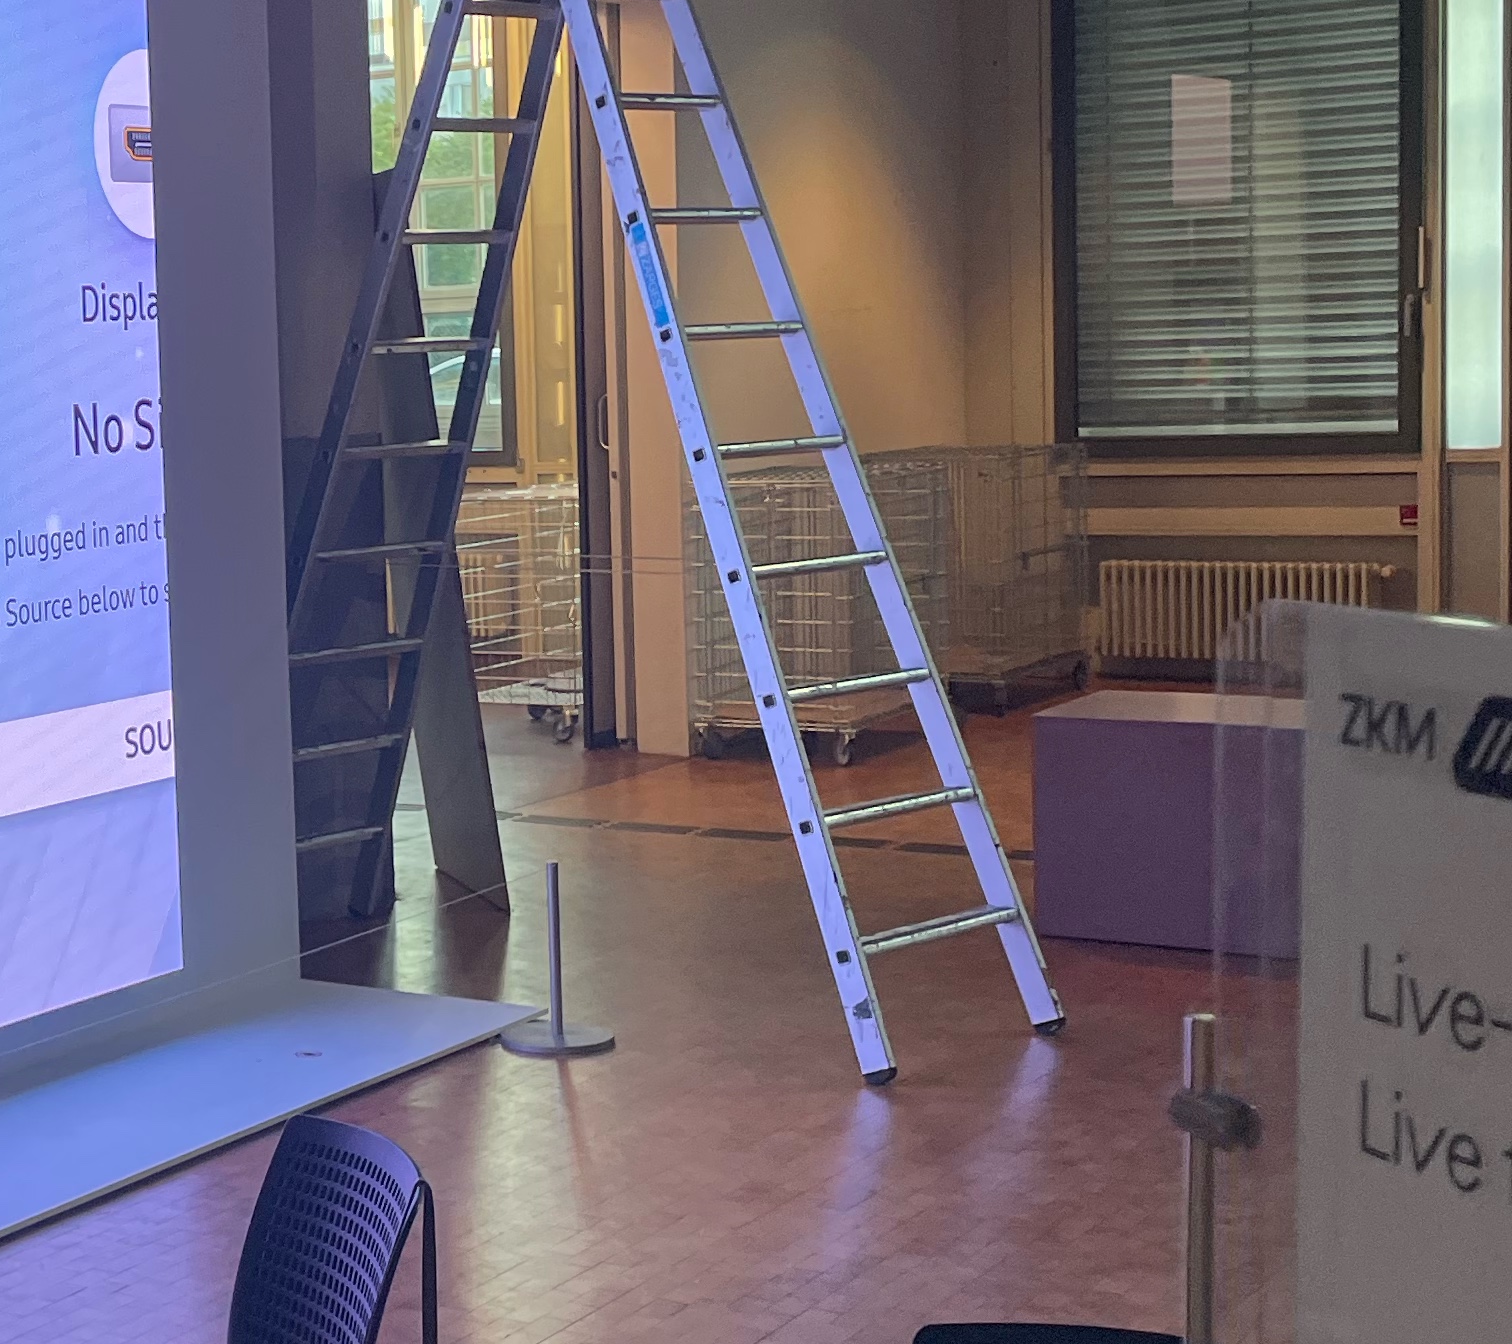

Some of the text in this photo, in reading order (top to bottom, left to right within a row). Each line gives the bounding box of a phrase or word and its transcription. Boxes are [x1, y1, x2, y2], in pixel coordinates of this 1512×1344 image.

[72, 402, 124, 456] No
[4, 522, 86, 566] plugged
[92, 520, 110, 548] in
[114, 514, 149, 545] and
[6, 598, 73, 628] Source
[78, 585, 136, 616] below
[139, 581, 159, 607] to
[125, 718, 172, 759] SOU
[1340, 692, 1436, 762] ZKM
[1360, 1078, 1484, 1194] Live
